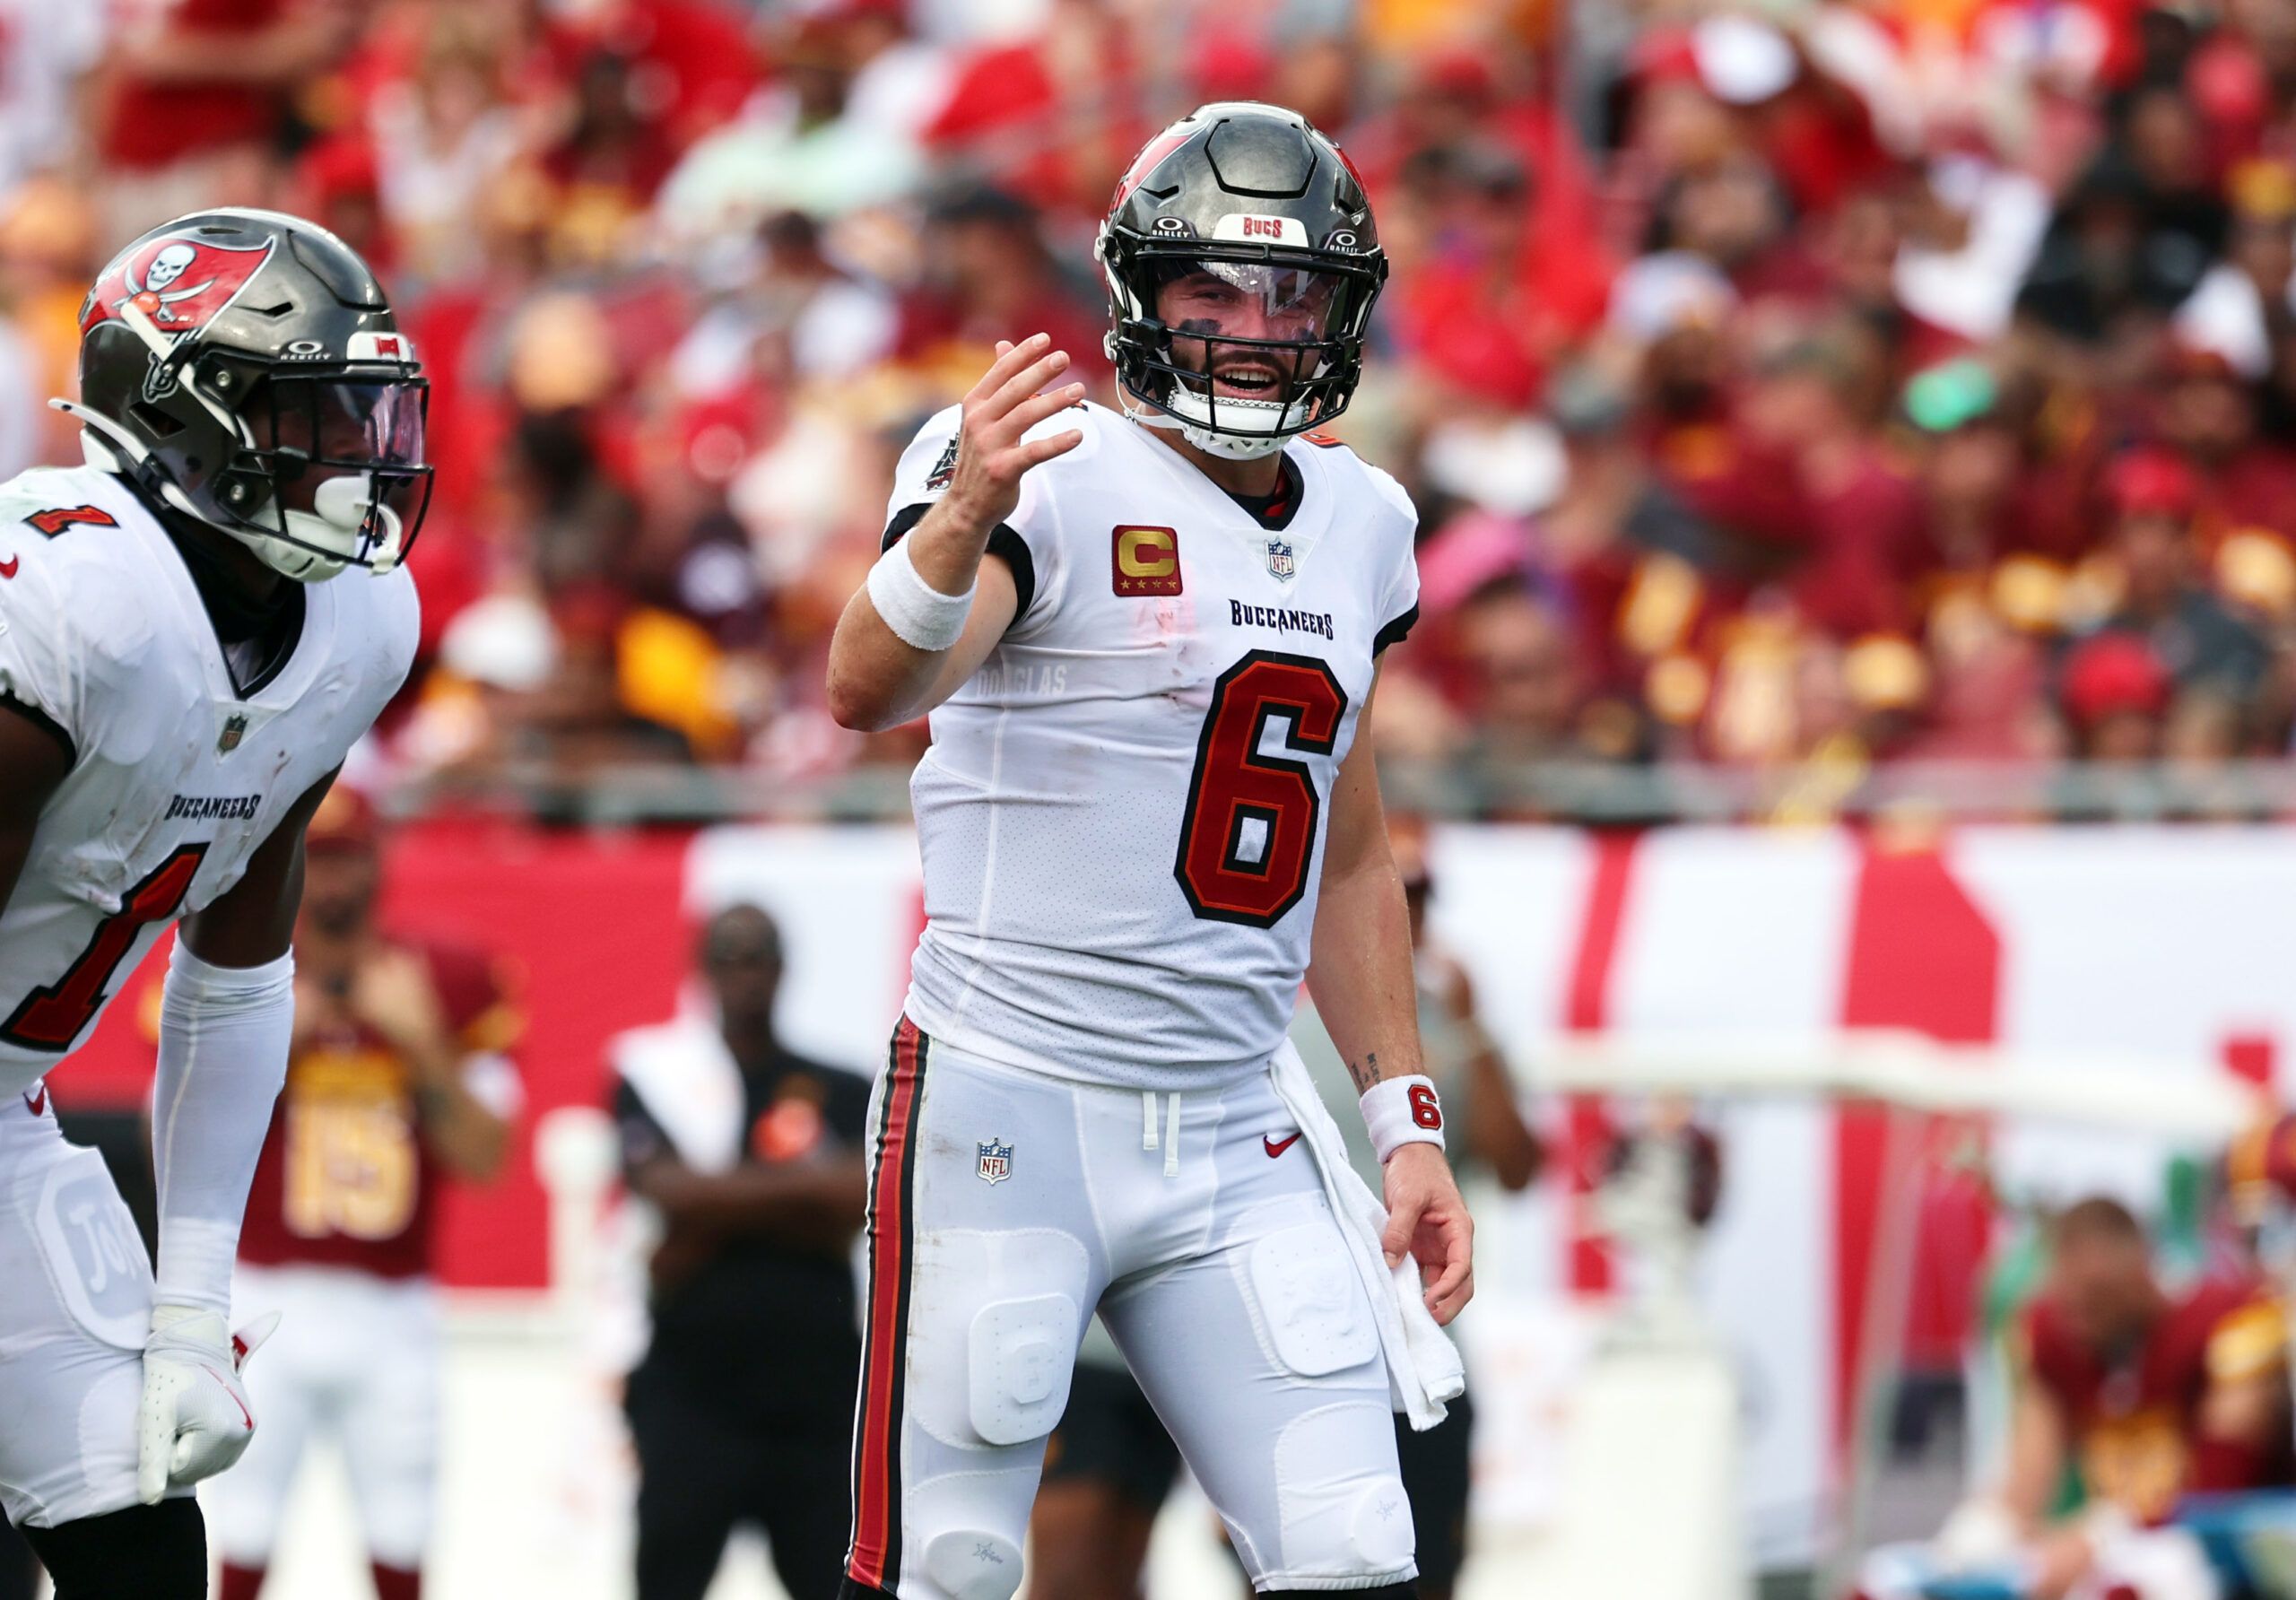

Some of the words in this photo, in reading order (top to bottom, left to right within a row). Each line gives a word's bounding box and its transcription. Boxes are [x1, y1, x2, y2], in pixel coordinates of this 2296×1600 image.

[1152, 229, 1190, 239] OAKLEY
[1243, 217, 1282, 238] BUCS
[1118, 530, 1175, 578] C
[1272, 555, 1292, 573] NFL
[1228, 598, 1334, 640] BUCCANEERS
[1174, 648, 1347, 929] 6
[163, 794, 262, 825] BUCCANEERS
[0, 841, 212, 1053] 1
[1407, 1083, 1442, 1131] 6
[982, 1158, 1006, 1177] NFL
